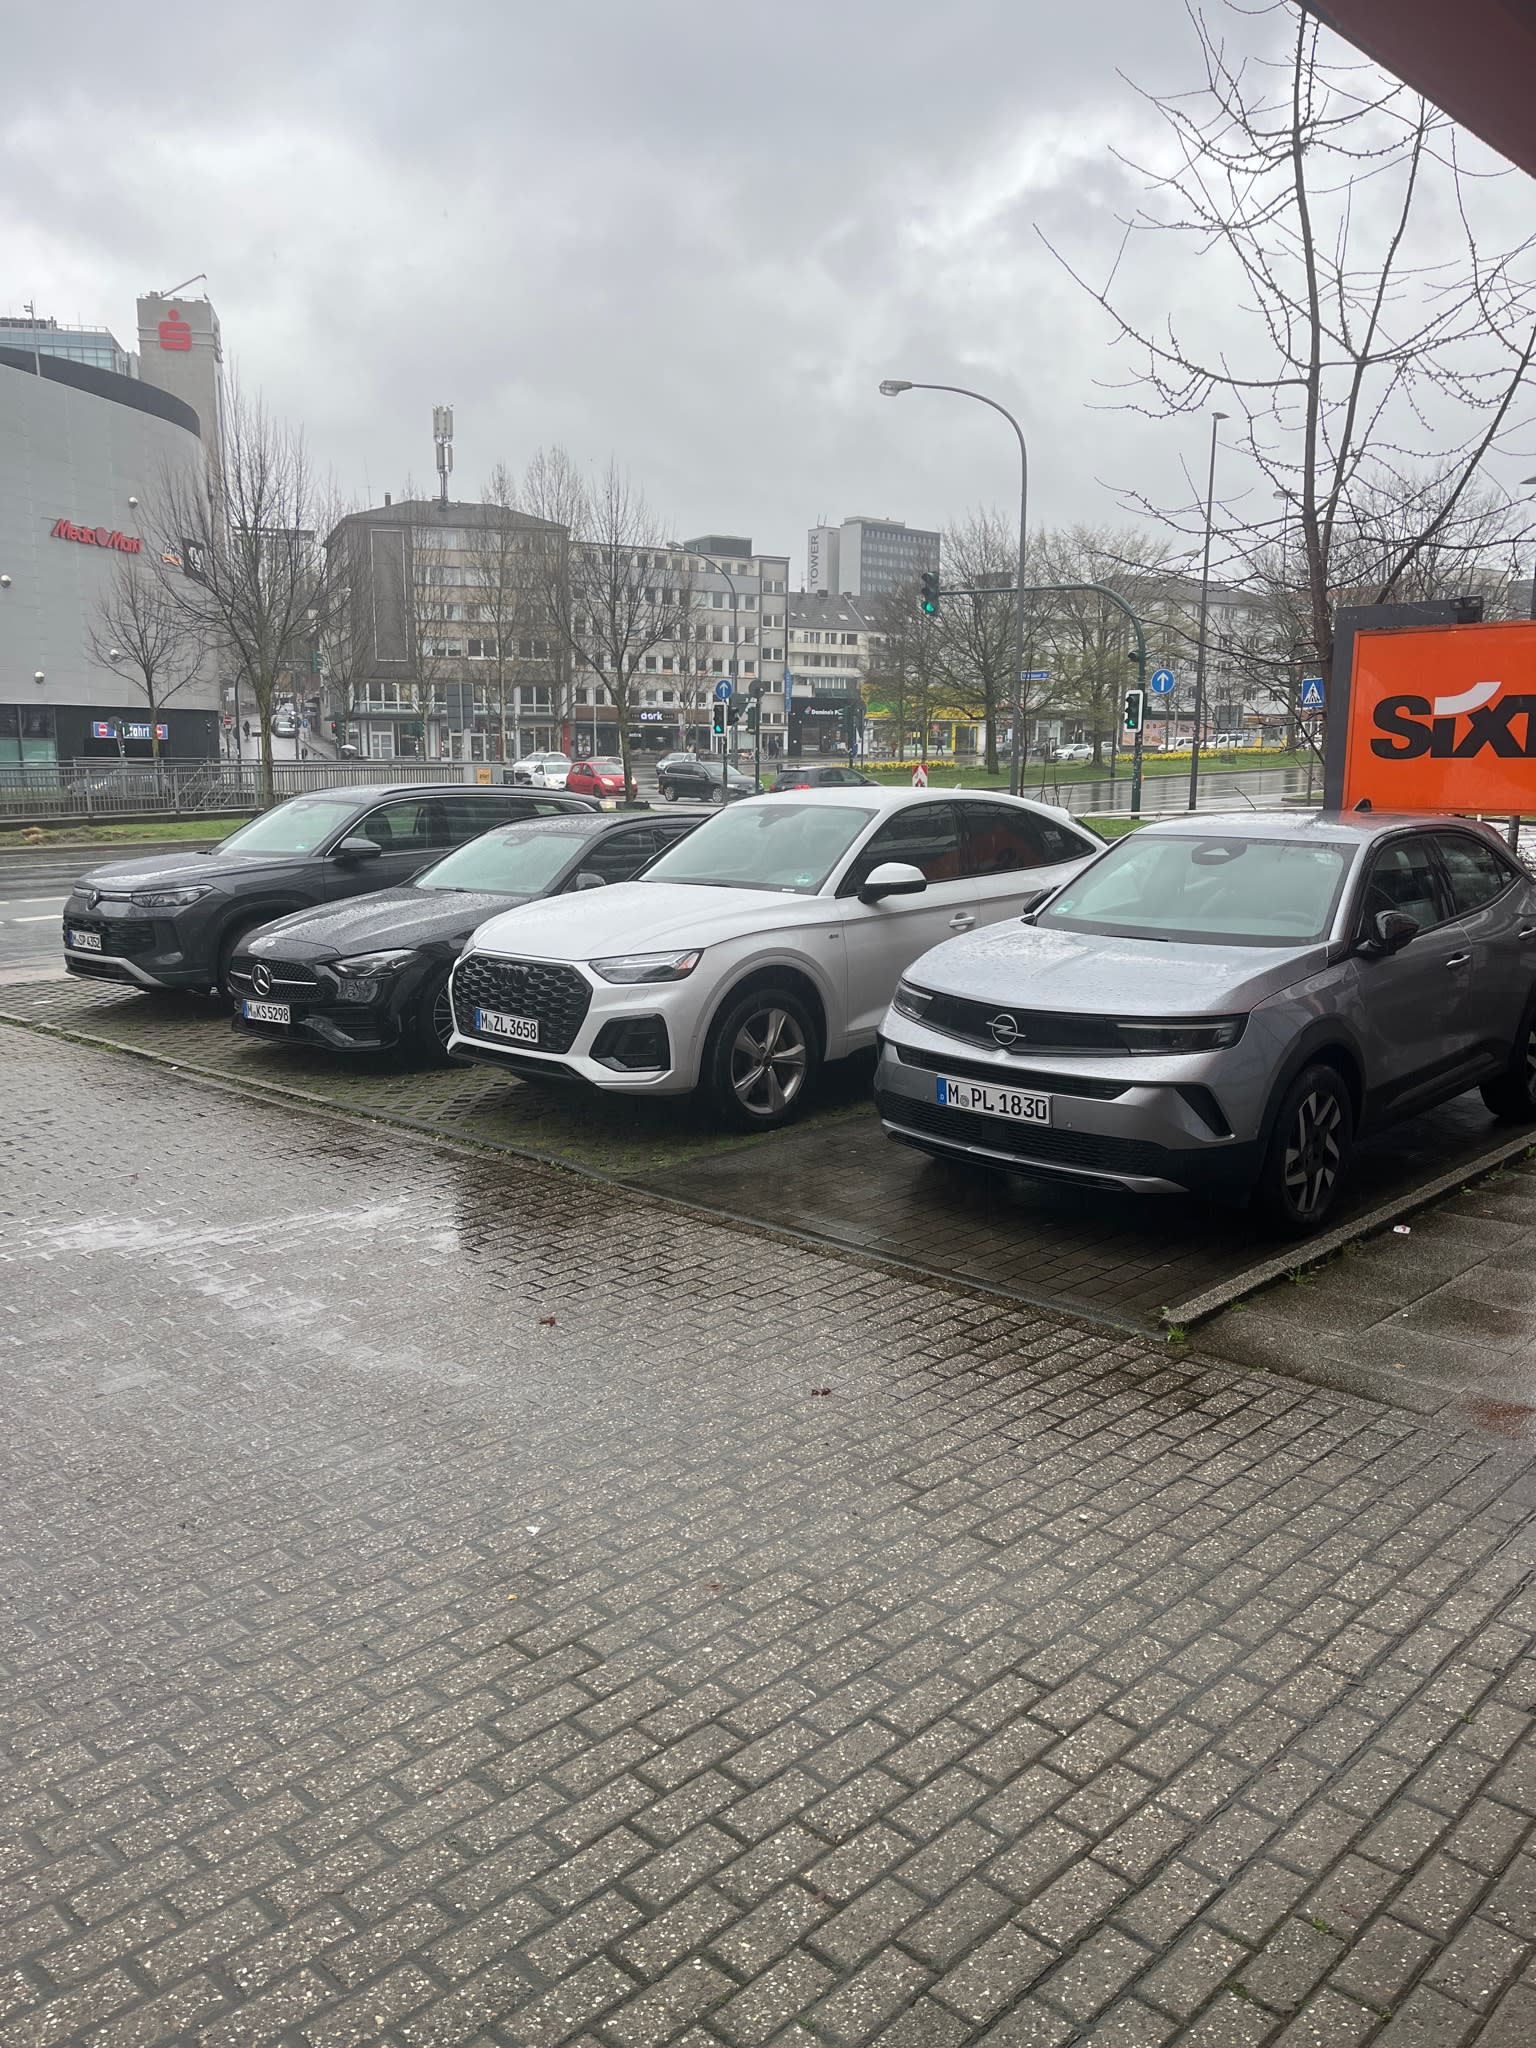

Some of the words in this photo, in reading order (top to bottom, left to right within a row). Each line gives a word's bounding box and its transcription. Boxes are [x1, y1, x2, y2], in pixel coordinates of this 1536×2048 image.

[51, 518, 97, 545] Media
[105, 530, 144, 554] Markt
[641, 711, 663, 720] dark
[481, 1012, 488, 1030] M
[494, 1015, 507, 1033] ZL
[509, 1018, 537, 1039] 3658
[948, 1083, 959, 1104] M
[971, 1088, 995, 1111] PL
[999, 1094, 1047, 1120] 1830
